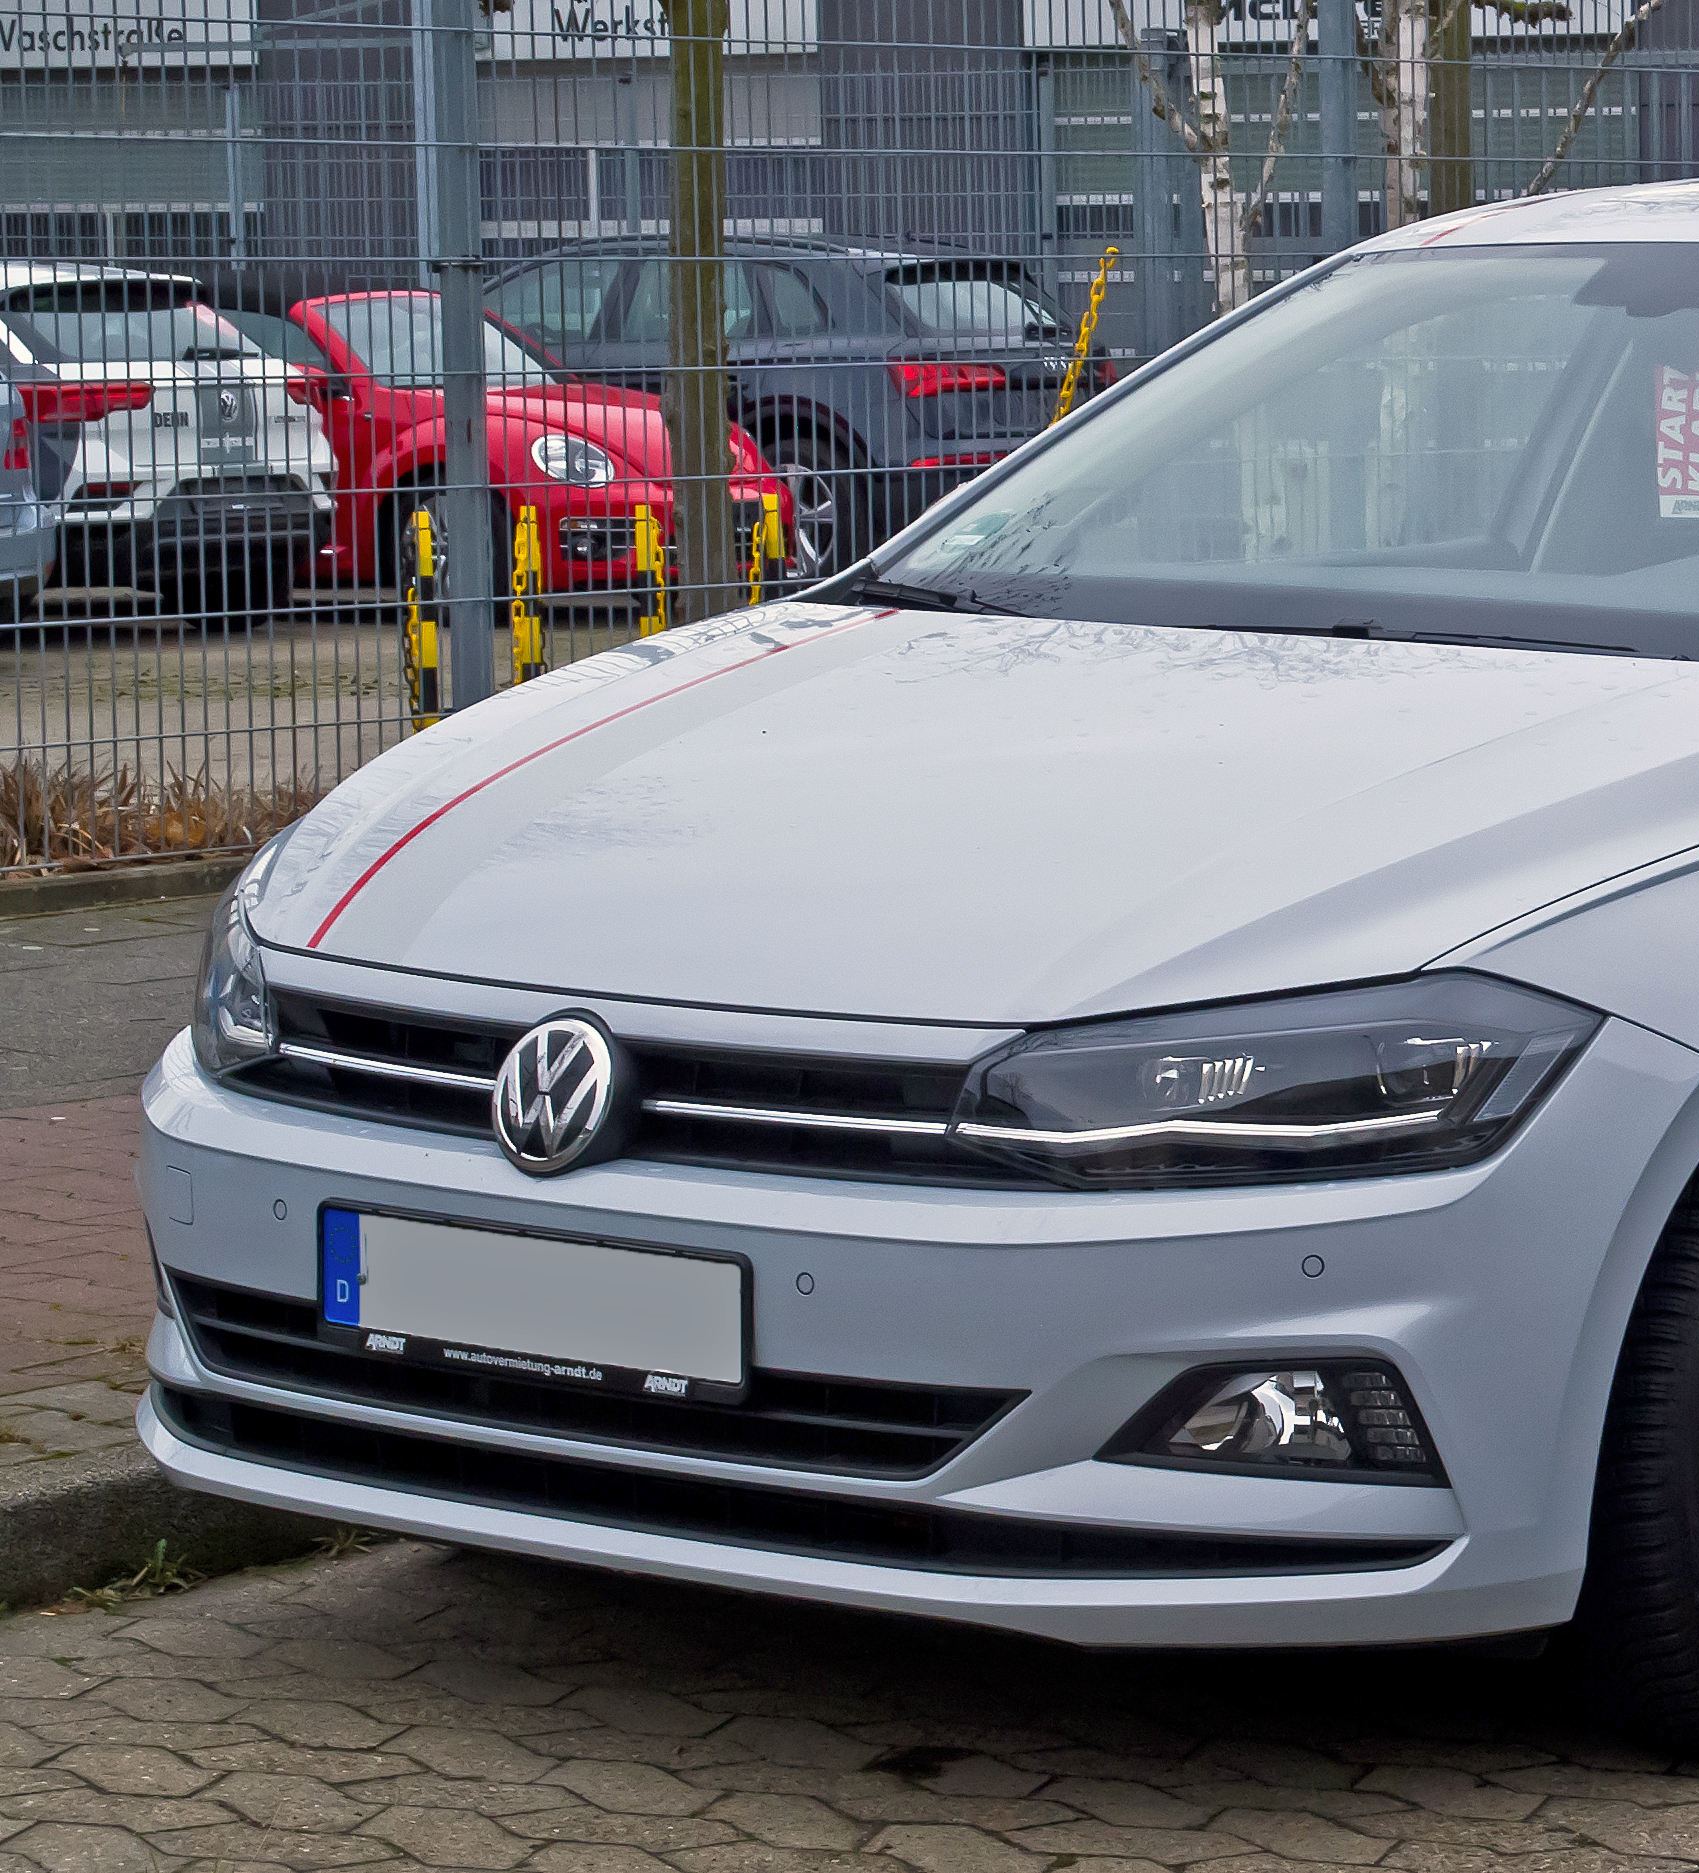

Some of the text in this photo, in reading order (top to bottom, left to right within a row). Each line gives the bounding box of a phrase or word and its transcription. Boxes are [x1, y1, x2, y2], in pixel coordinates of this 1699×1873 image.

[553, 4, 670, 42] Werkst
[336, 1279, 349, 1303] D
[443, 1347, 603, 1381] www.autovermietung-arndt.de
